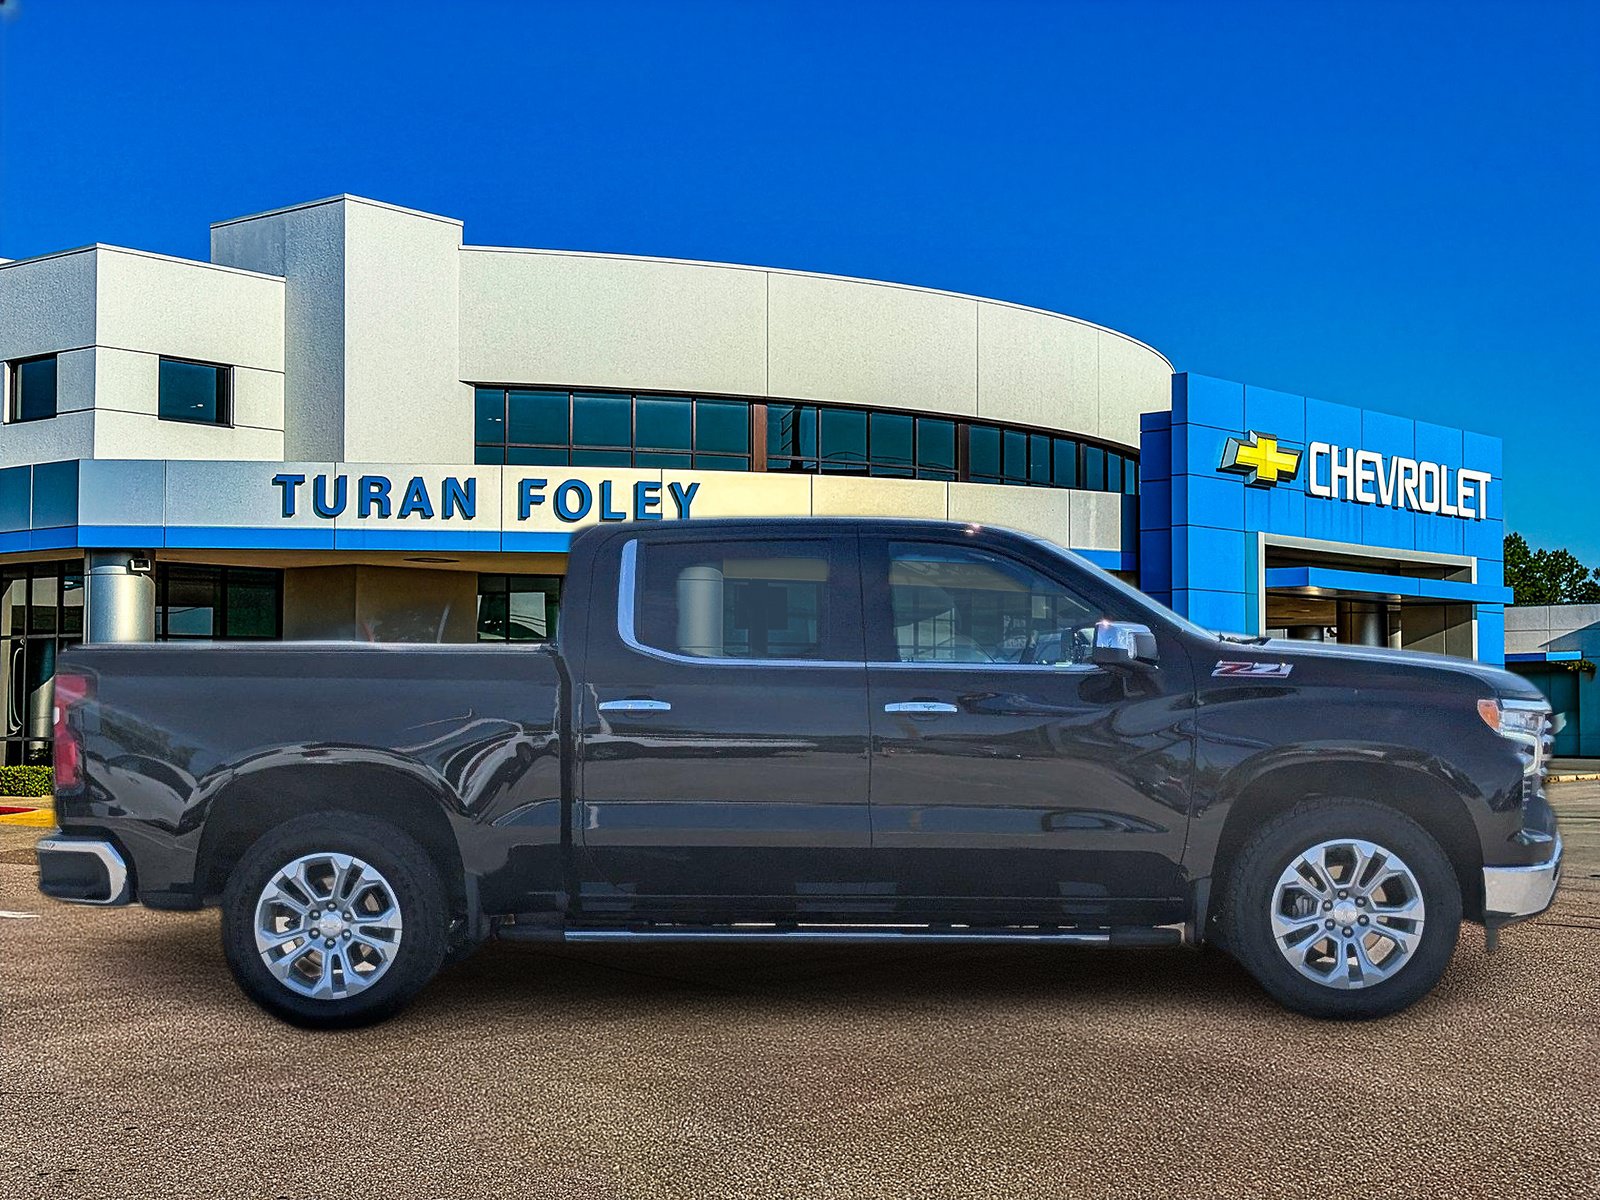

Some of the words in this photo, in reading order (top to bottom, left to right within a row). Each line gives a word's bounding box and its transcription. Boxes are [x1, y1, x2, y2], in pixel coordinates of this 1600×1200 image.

[272, 474, 477, 519] TURAN
[517, 478, 701, 522] FOLEY
[1308, 441, 1492, 520] CHEVROLET
